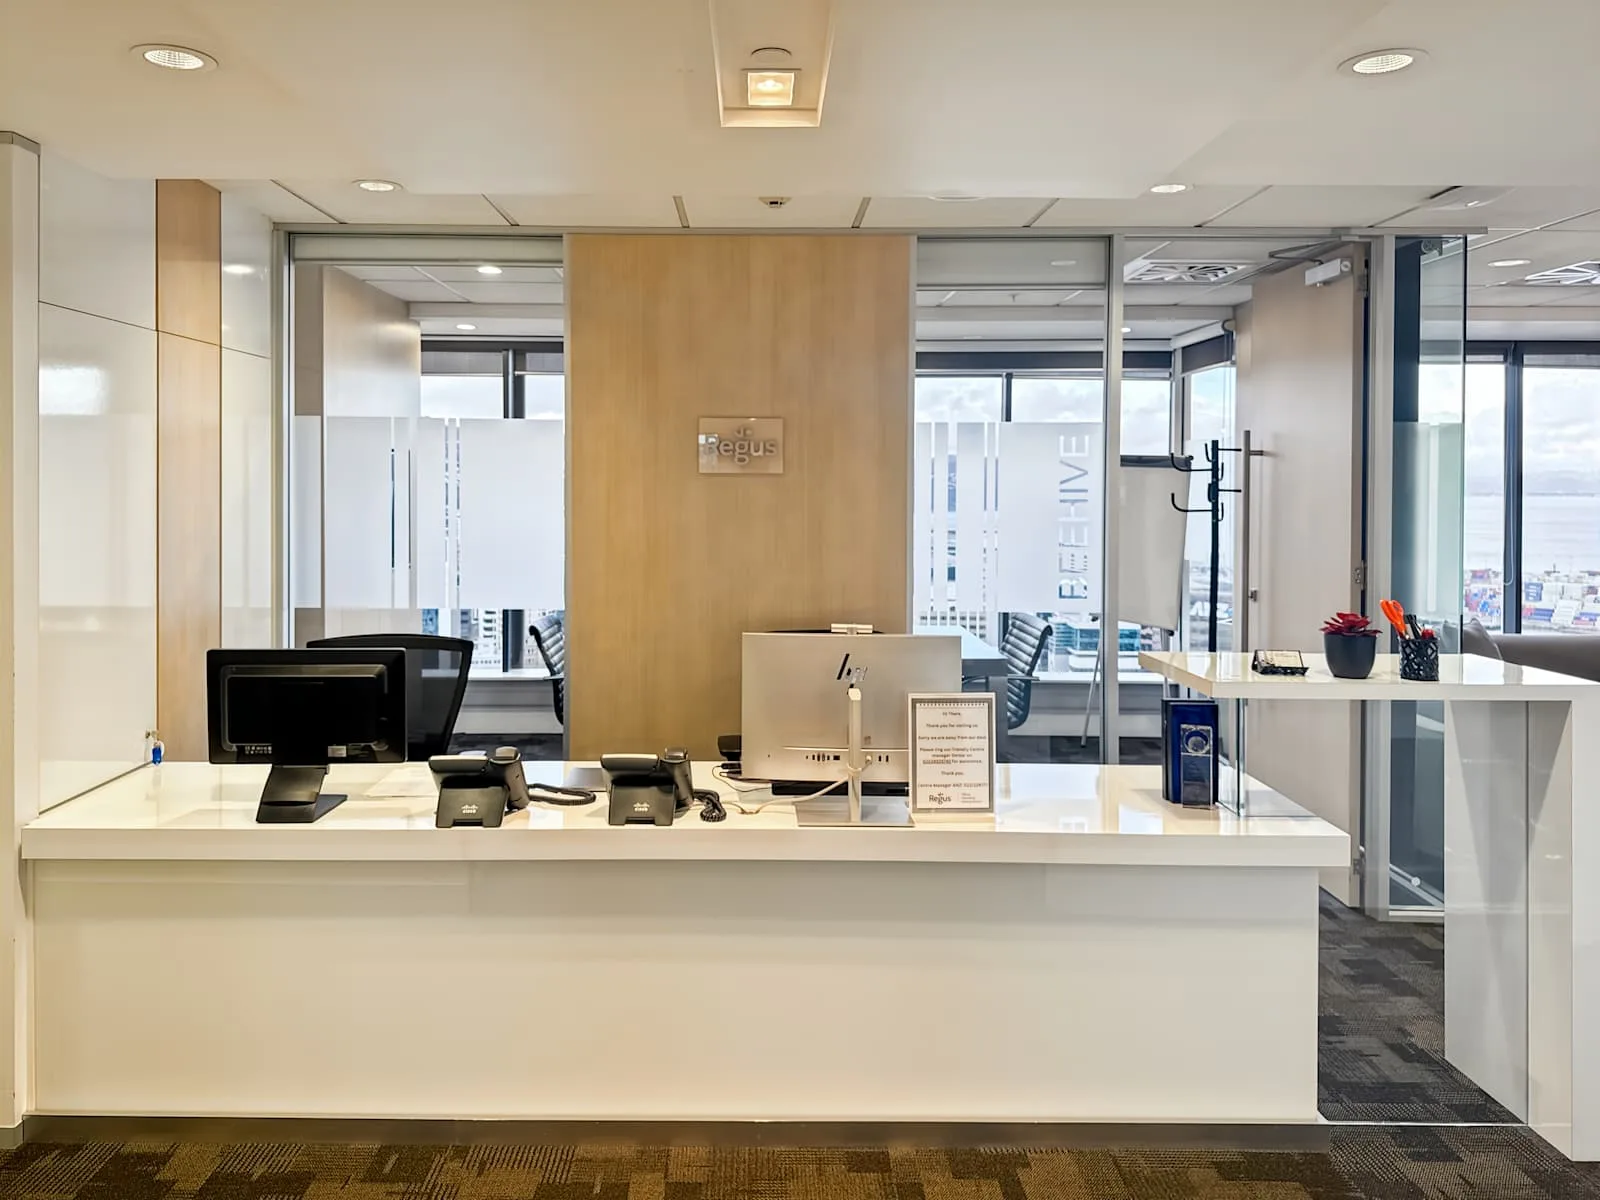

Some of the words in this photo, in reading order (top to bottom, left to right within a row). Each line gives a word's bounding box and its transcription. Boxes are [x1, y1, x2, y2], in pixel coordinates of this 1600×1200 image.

[704, 433, 778, 466] Regus
[1058, 434, 1090, 600] BEEHIVE
[928, 793, 952, 805] Regus
